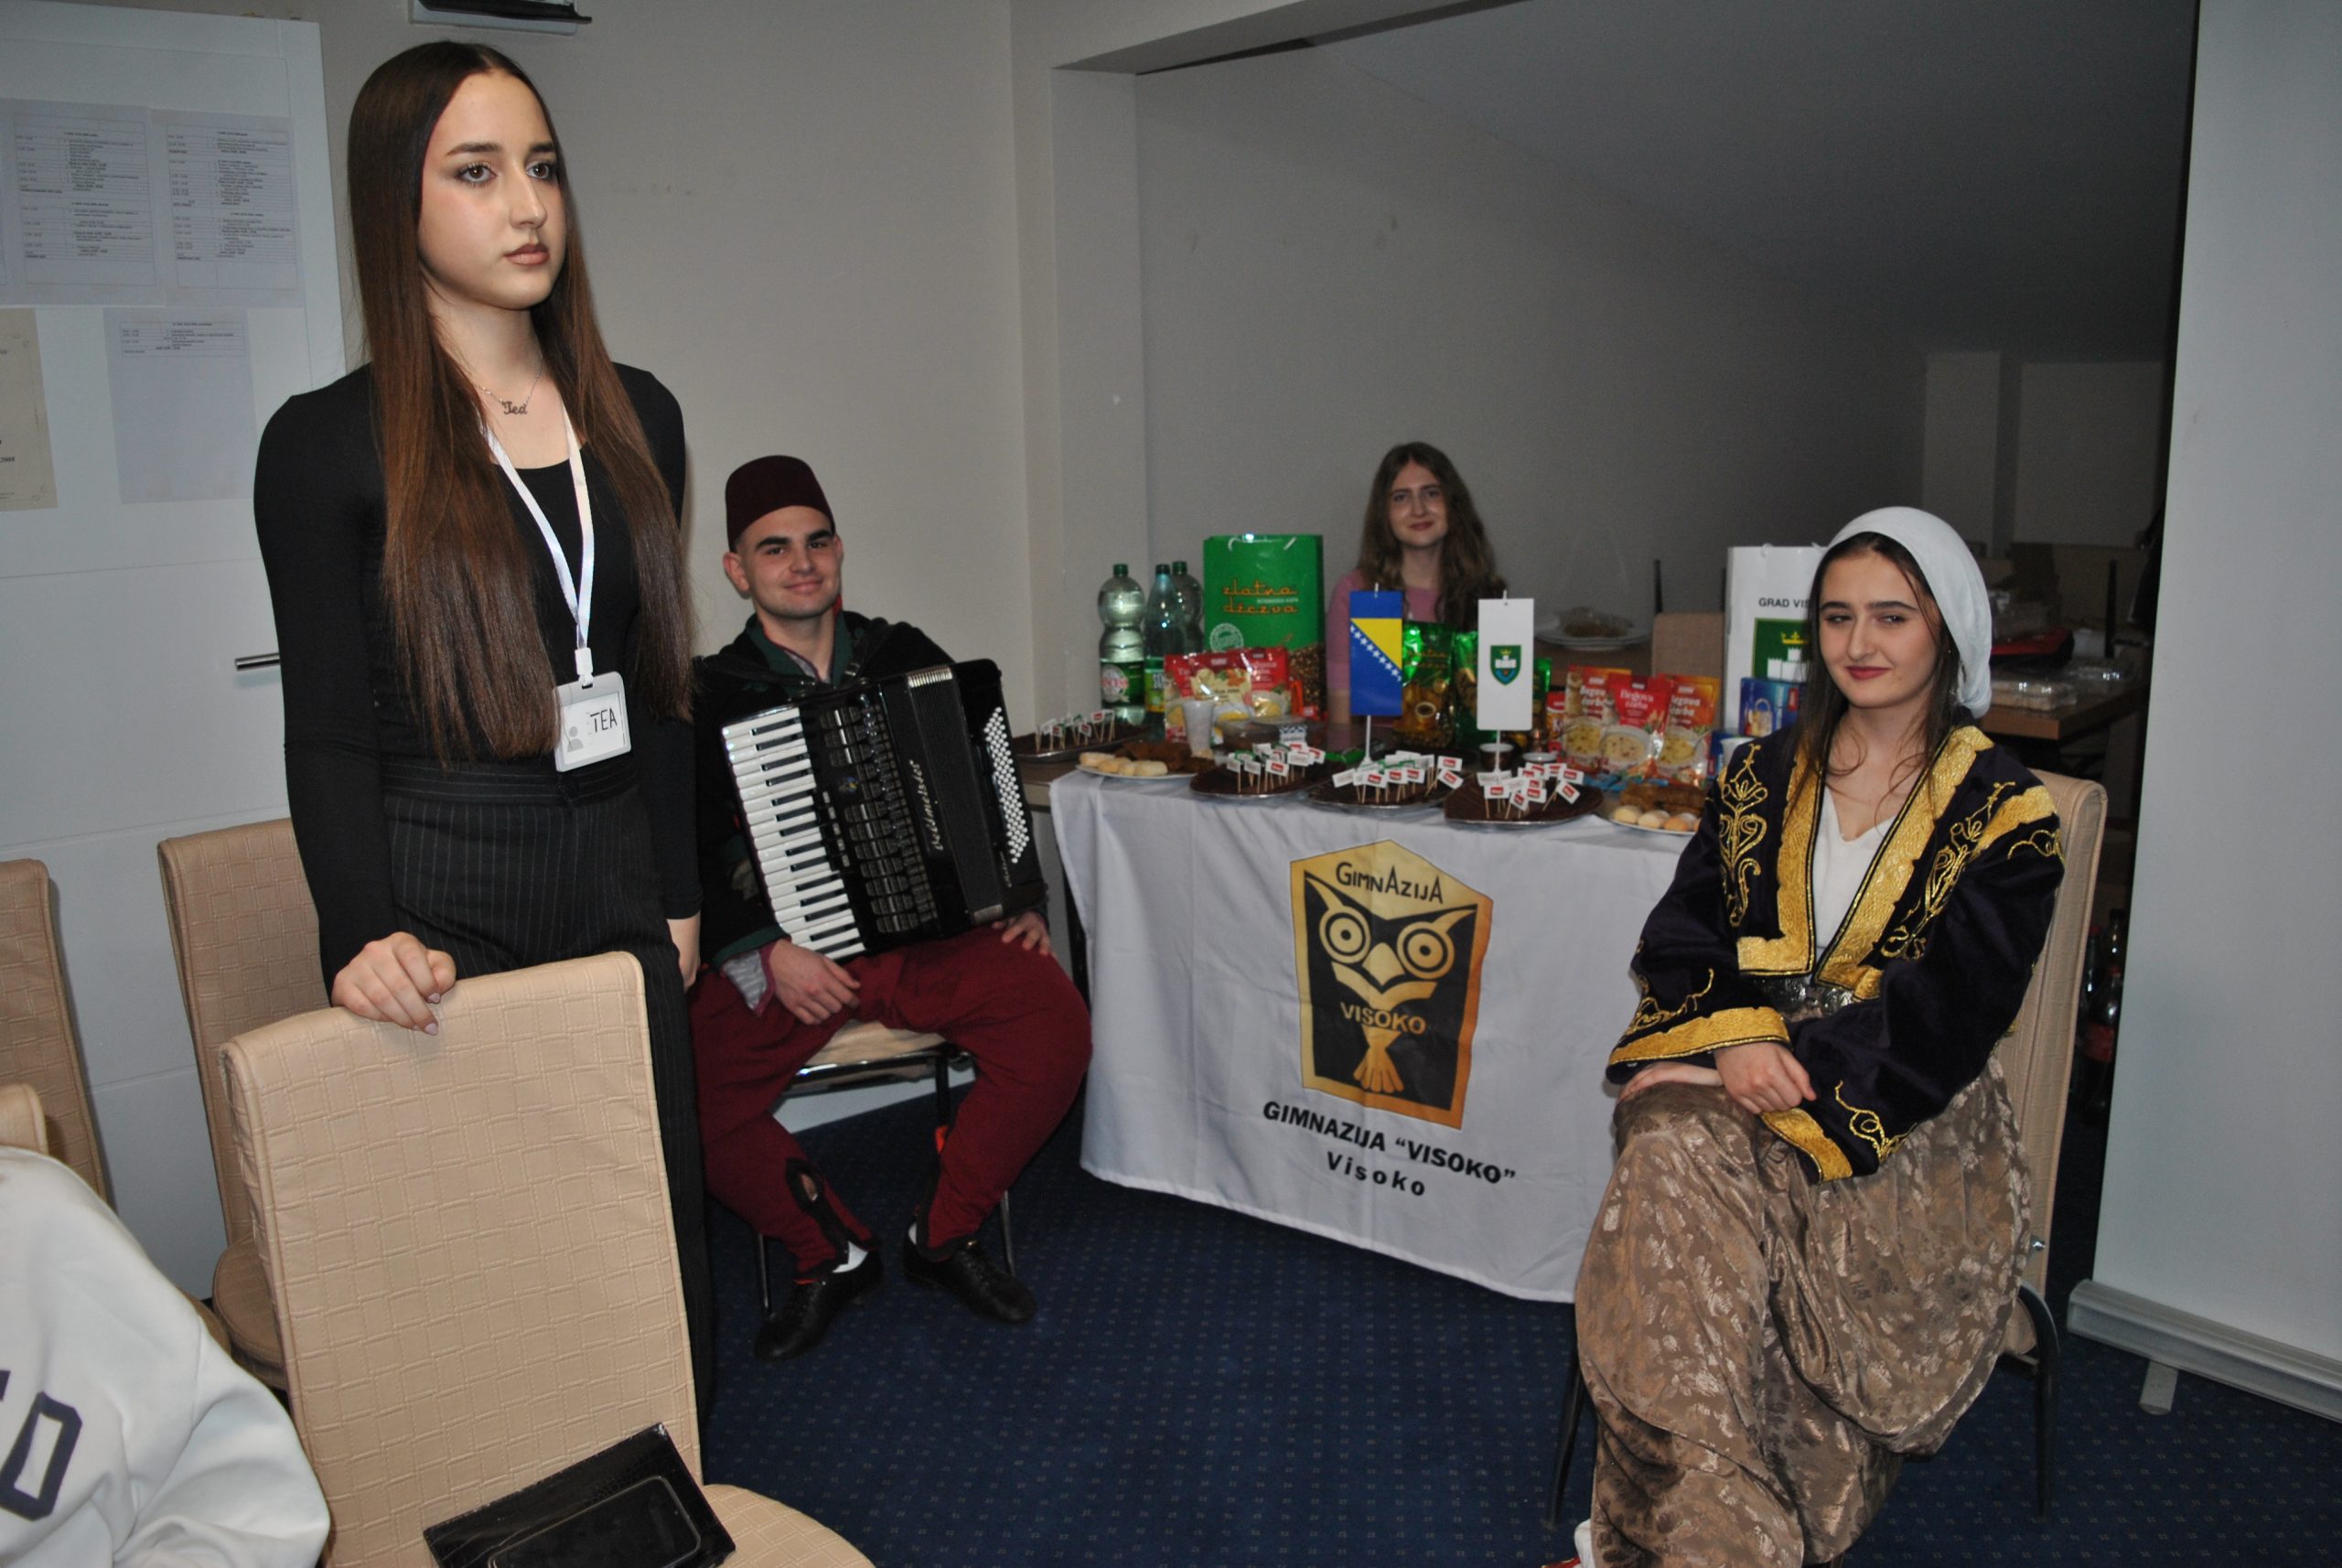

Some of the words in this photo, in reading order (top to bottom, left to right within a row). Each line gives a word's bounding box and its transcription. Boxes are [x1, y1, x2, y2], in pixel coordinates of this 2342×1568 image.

[1758, 596, 1790, 608] GRAD
[590, 706, 618, 734] TEA
[1339, 1001, 1427, 1035] VISOKO
[1262, 1101, 1386, 1152] GIMNAZIJA
[1327, 1151, 1425, 1197] Visoko
